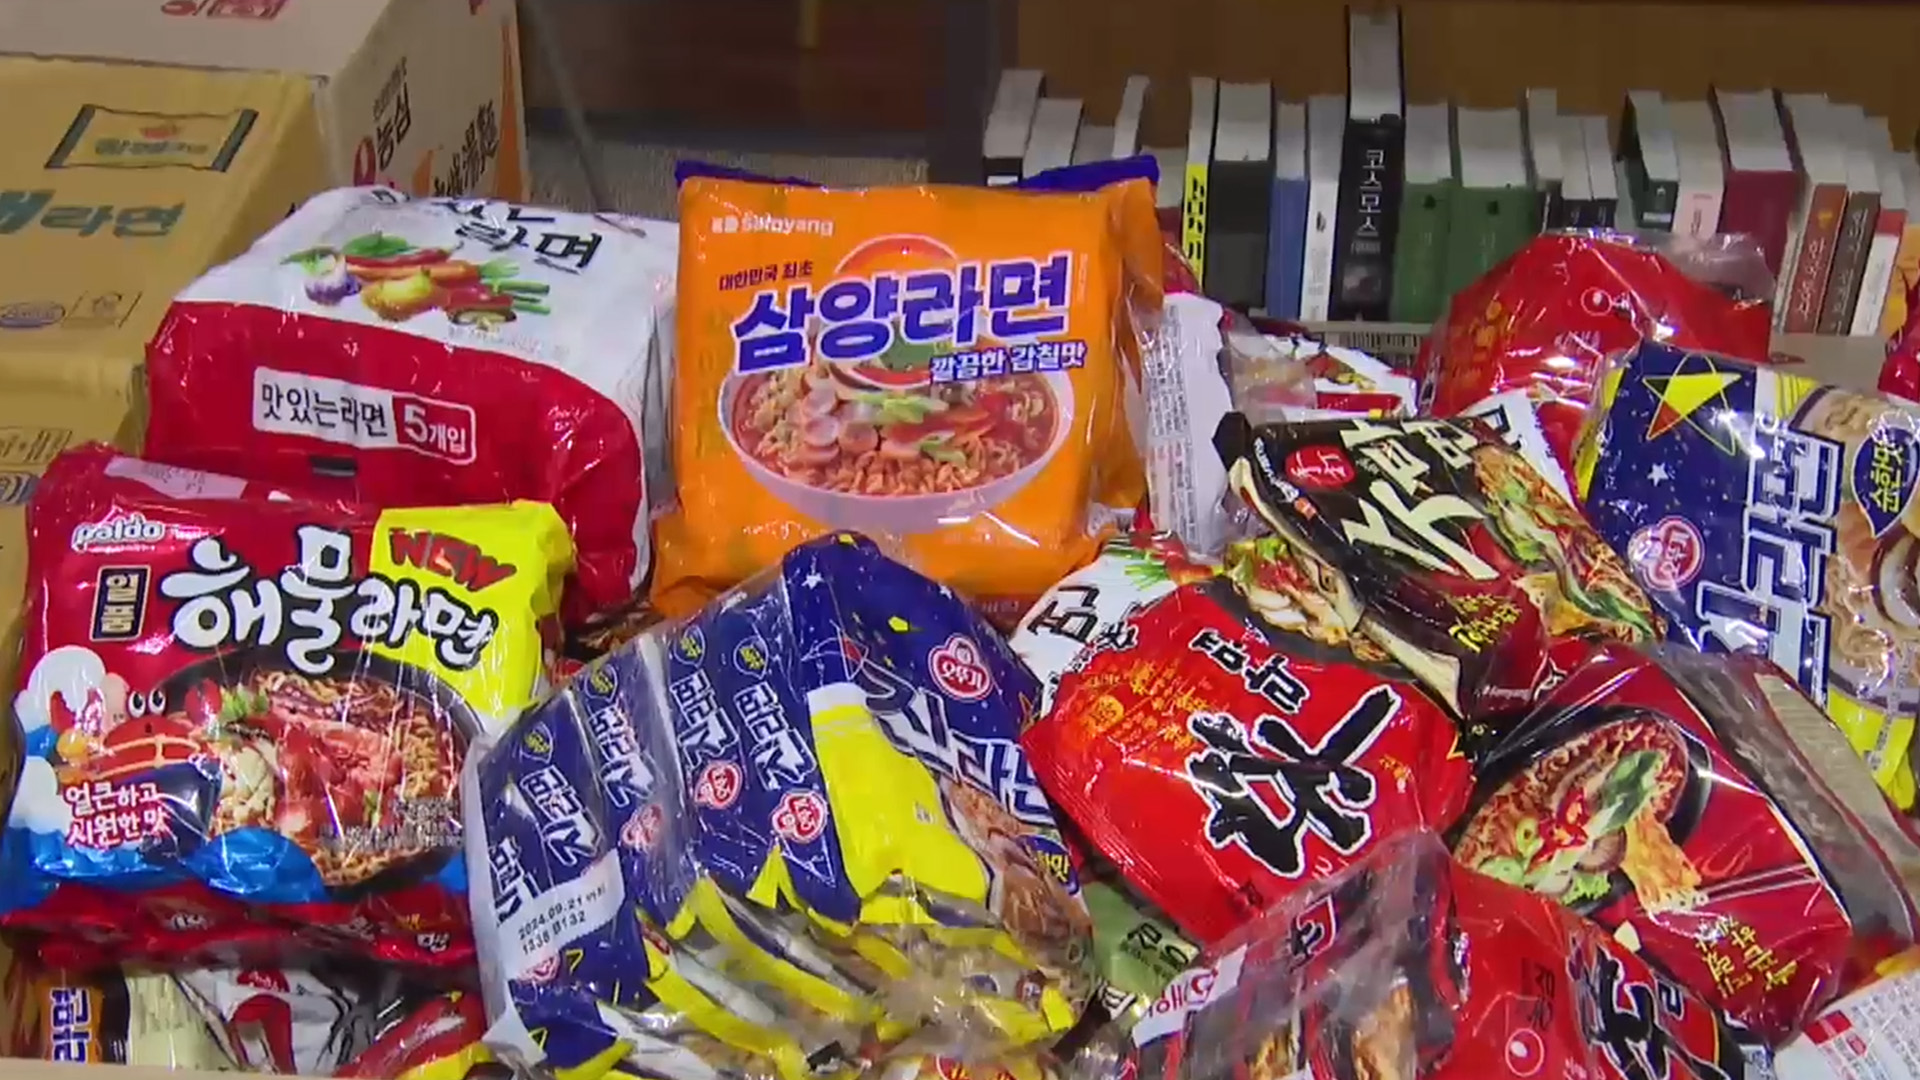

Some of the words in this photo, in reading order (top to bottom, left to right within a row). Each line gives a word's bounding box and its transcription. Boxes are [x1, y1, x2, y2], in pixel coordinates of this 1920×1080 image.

[1356, 149, 1386, 237] 코스모스
[718, 263, 779, 291] 대한민국
[782, 259, 814, 281] 최초
[731, 251, 1075, 374] 삼양라면
[930, 351, 1007, 383] 깔끔한
[1010, 342, 1087, 373] 감칠맛
[261, 384, 388, 438] 맛있는라면
[403, 404, 467, 456] 5개입
[1869, 440, 1903, 514] 순한맛
[72, 517, 164, 551] paldo
[389, 526, 517, 592] NEW
[1659, 530, 1692, 580] 오뚜기
[101, 572, 140, 635] 일품
[160, 524, 498, 672] 해물라면
[941, 661, 984, 688] 오뚜기
[1190, 628, 1311, 713] 라면
[669, 668, 739, 769] 진라면
[733, 681, 817, 792] 진라면
[587, 704, 656, 808] 진라면
[66, 782, 162, 817] 얼큰하고
[66, 809, 142, 846] 시원한
[143, 806, 172, 836] 맛
[520, 764, 600, 868] 진라면
[518, 894, 583, 941] 2024.09.21
